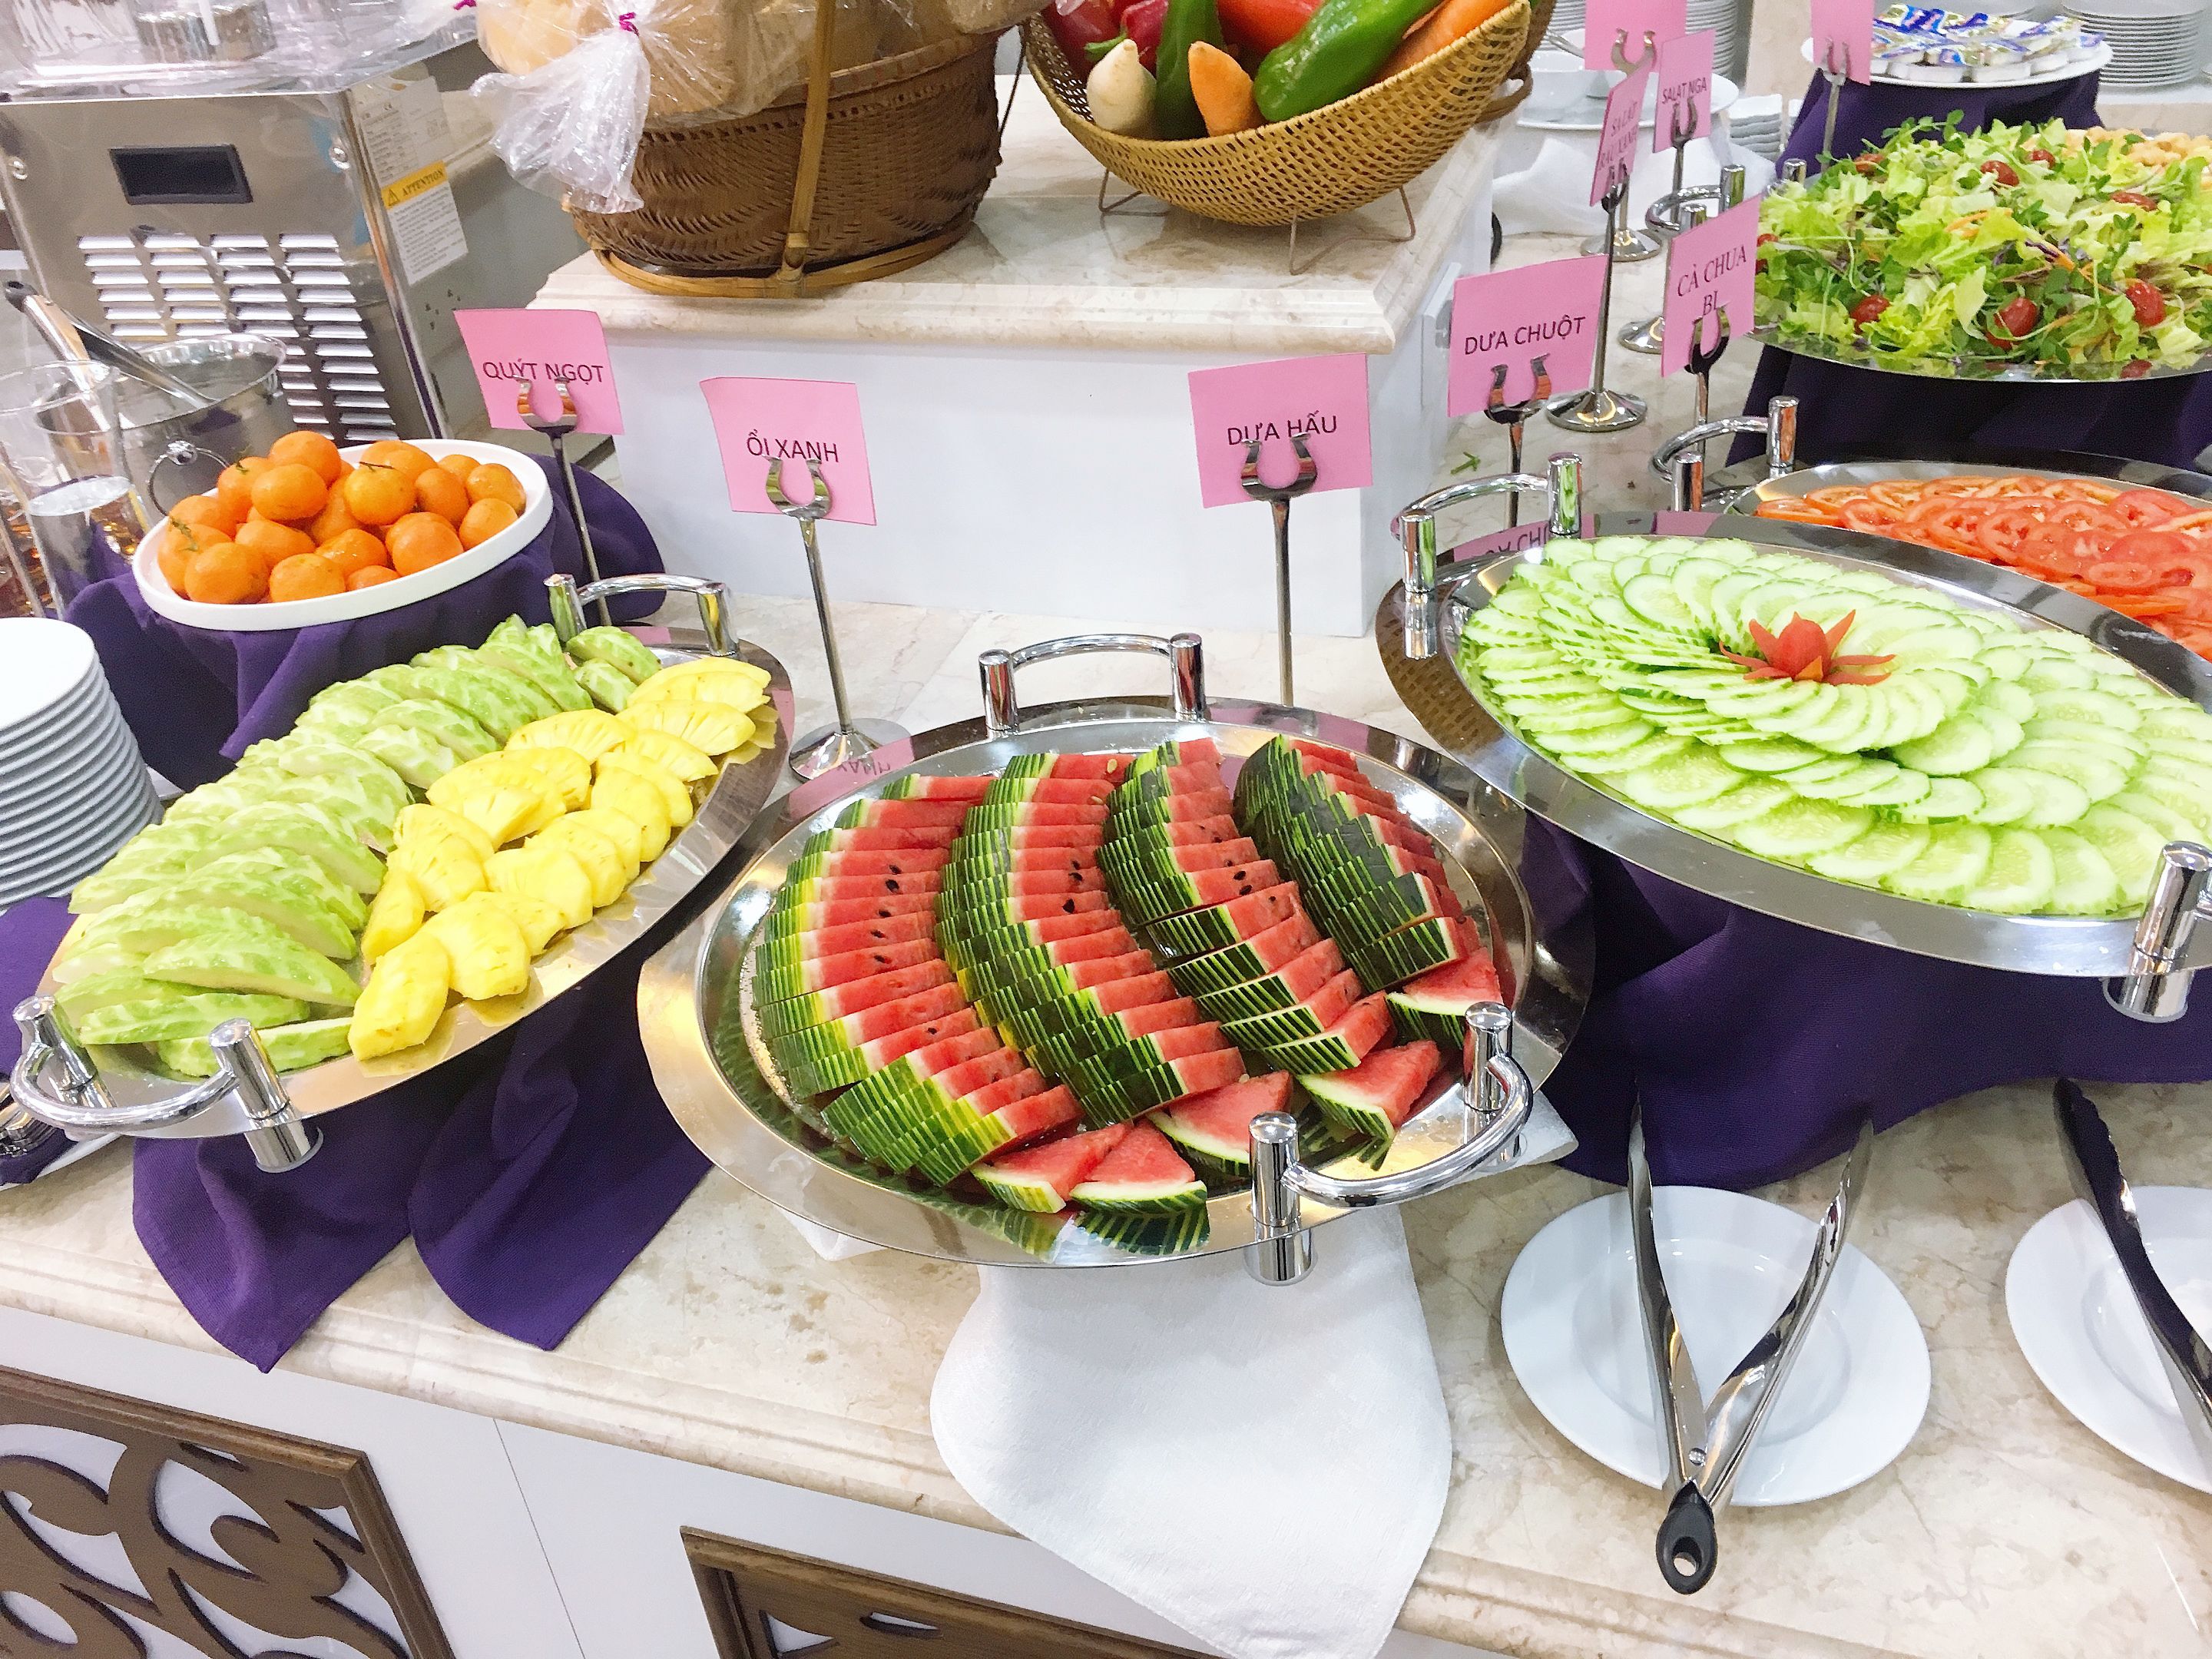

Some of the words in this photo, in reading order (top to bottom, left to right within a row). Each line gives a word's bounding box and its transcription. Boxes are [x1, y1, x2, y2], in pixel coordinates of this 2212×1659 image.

[1662, 82, 1688, 104] SALAT
[1689, 77, 1707, 94] NGA
[402, 168, 445, 197] ATTENTION
[1677, 263, 1699, 296] CÀ
[1704, 245, 1747, 283] CHUA
[1703, 290, 1718, 316] BI
[1465, 331, 1509, 355] DƯA
[1515, 314, 1586, 345] CHUỘT
[482, 358, 538, 380] QUÝT
[545, 363, 604, 385] NGỌT
[1227, 422, 1280, 445] DƯA
[1287, 410, 1337, 438] HẤU
[747, 429, 770, 456] ỔI
[775, 439, 839, 463] XANH
